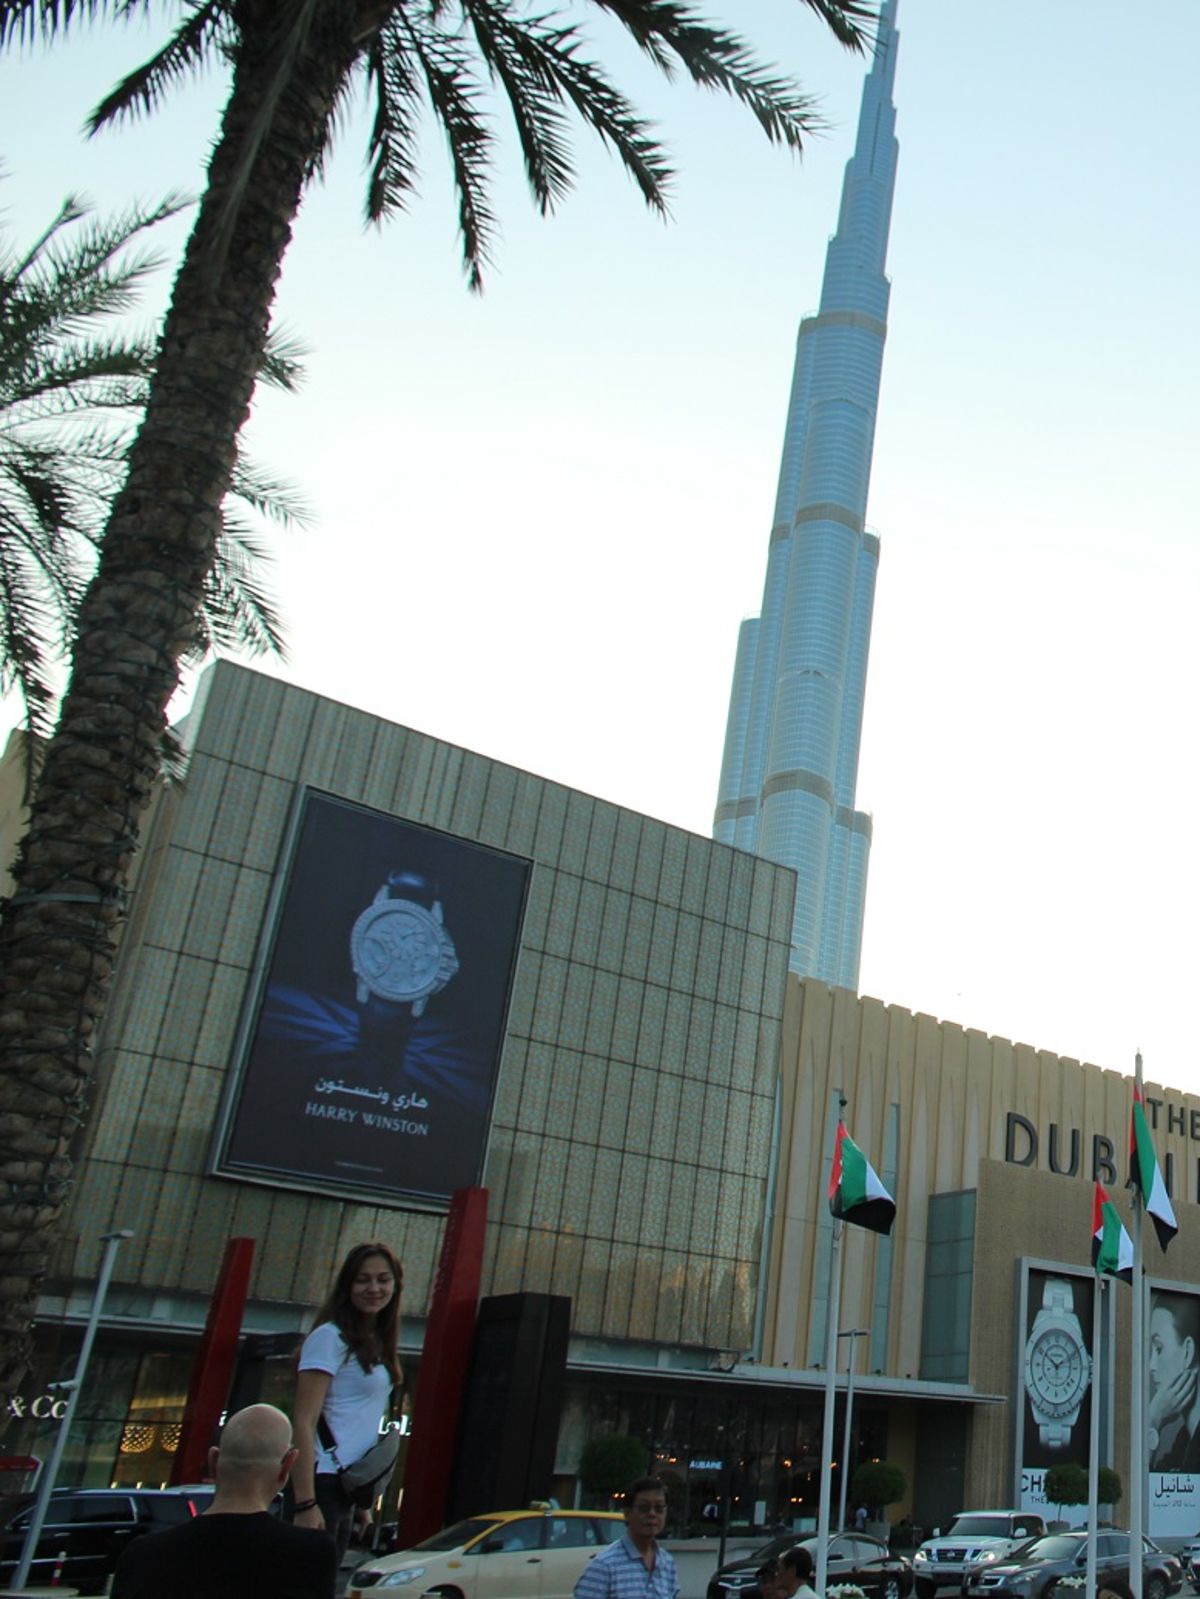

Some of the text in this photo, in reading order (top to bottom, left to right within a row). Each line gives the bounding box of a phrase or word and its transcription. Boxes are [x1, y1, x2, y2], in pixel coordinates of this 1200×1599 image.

[305, 1102, 429, 1136] HARRY WINSTON
[1005, 1111, 1174, 1200] DUBI
[1155, 1475, 1195, 1498] شانيل
